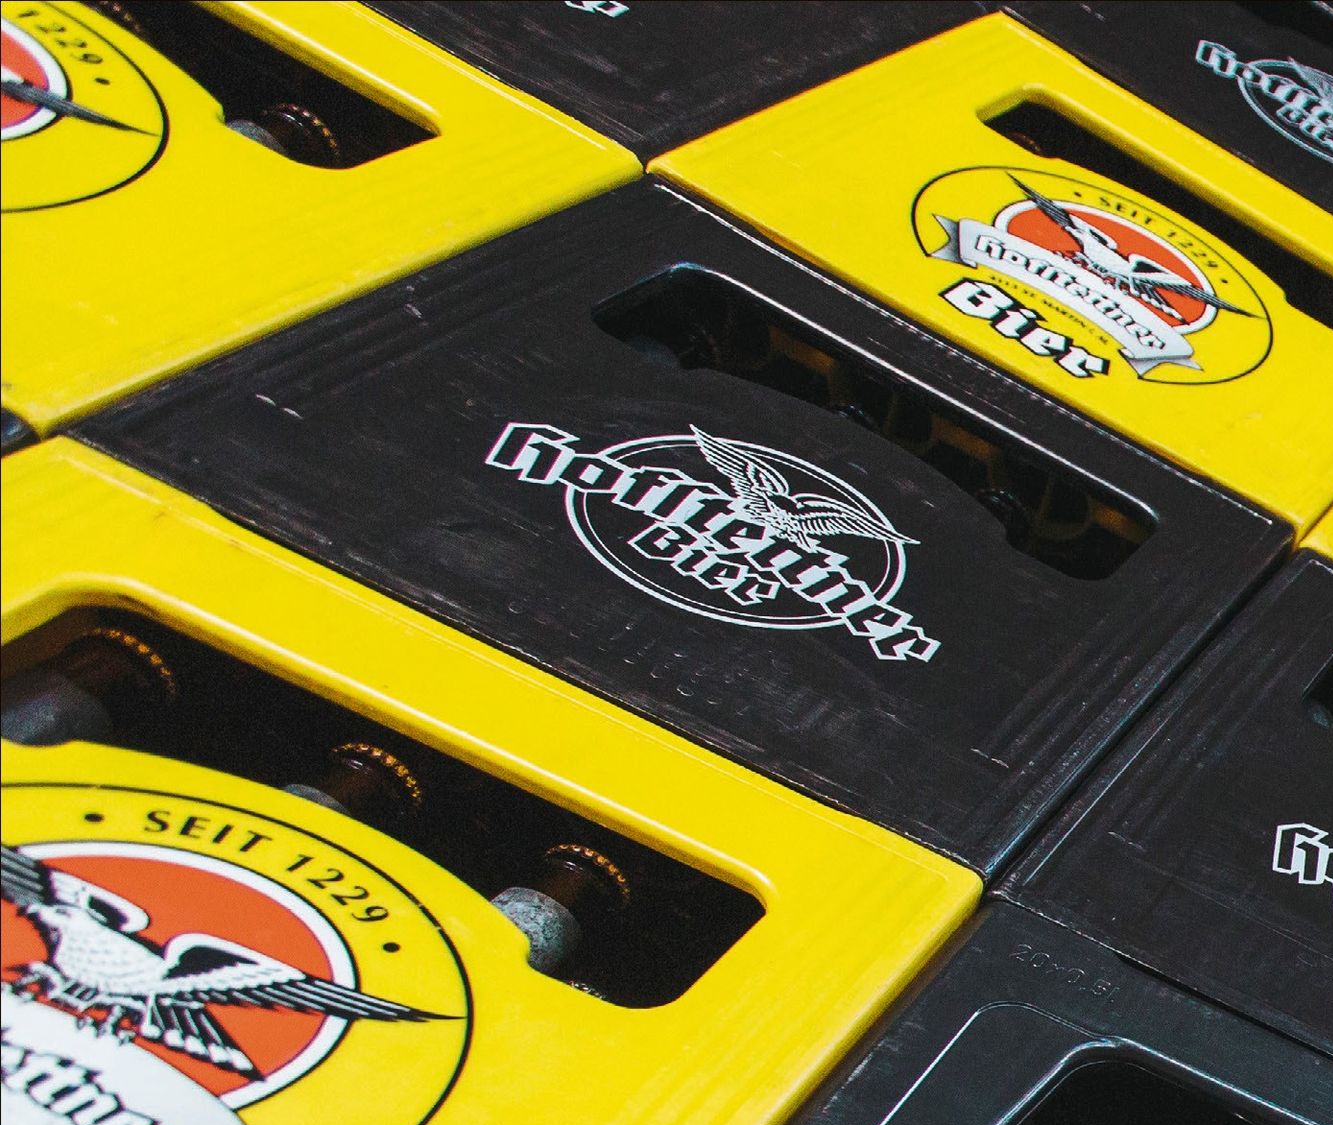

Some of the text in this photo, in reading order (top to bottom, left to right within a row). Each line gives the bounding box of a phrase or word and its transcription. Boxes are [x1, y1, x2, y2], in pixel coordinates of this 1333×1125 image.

[939, 277, 1110, 379] Bier
[628, 521, 783, 605] Bier
[144, 810, 390, 923] SEIT 1229
